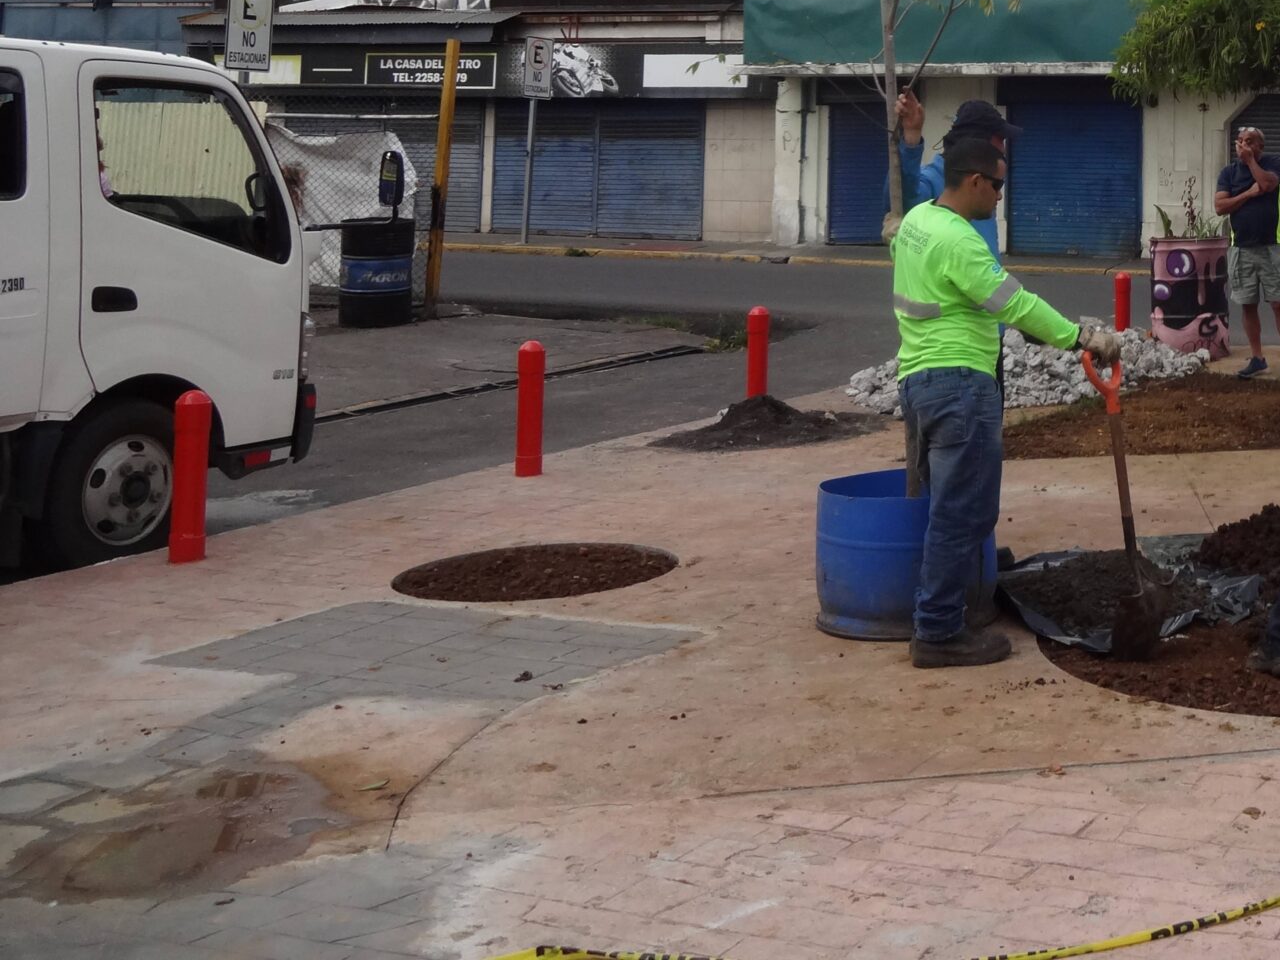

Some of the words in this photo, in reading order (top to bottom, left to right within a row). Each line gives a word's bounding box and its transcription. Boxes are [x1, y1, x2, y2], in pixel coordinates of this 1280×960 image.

[242, 31, 256, 48] NO
[228, 51, 267, 65] ESTACIONAR
[380, 59, 394, 69] LA
[395, 59, 423, 69] CASA
[424, 59, 444, 69] DEL
[392, 72, 413, 83] TEL:
[532, 71, 543, 83] NO
